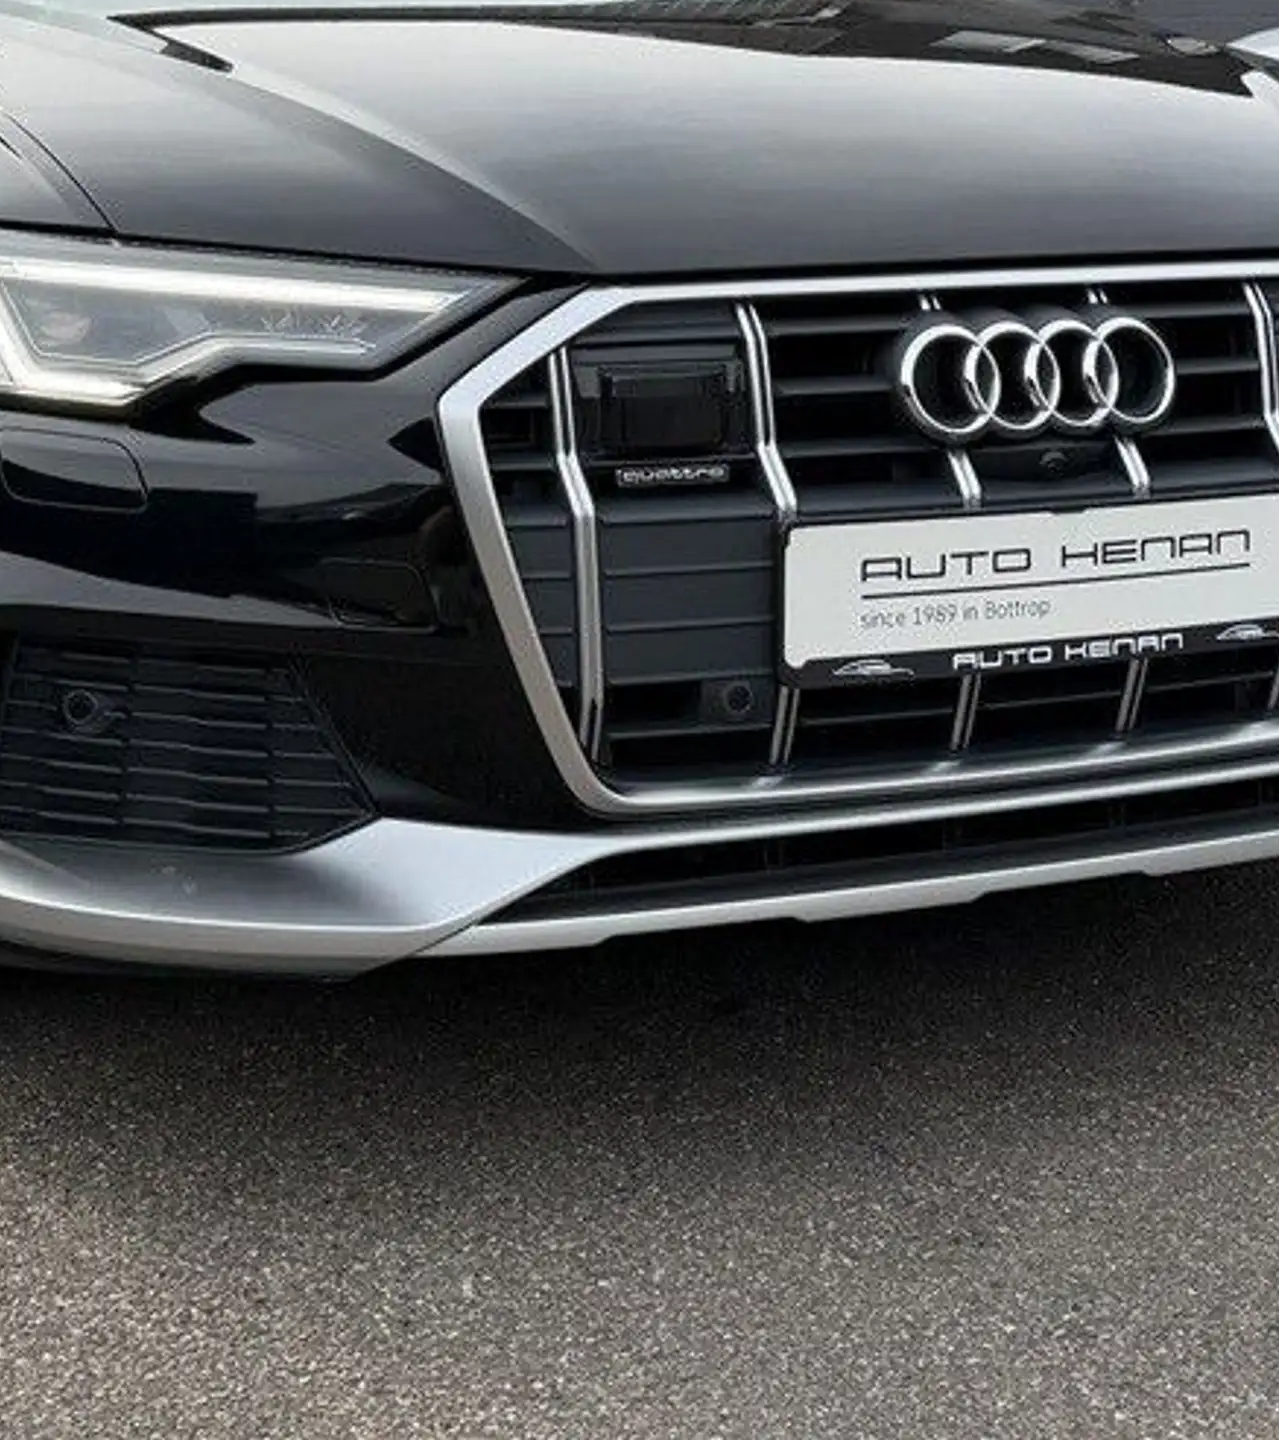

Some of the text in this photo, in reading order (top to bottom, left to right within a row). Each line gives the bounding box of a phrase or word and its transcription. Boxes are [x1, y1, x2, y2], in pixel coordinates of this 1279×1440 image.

[622, 463, 726, 484] quattro
[860, 547, 1032, 582] AUTO
[859, 598, 1052, 630] since 1989 in Bottrop
[952, 645, 1054, 671] AUTO
